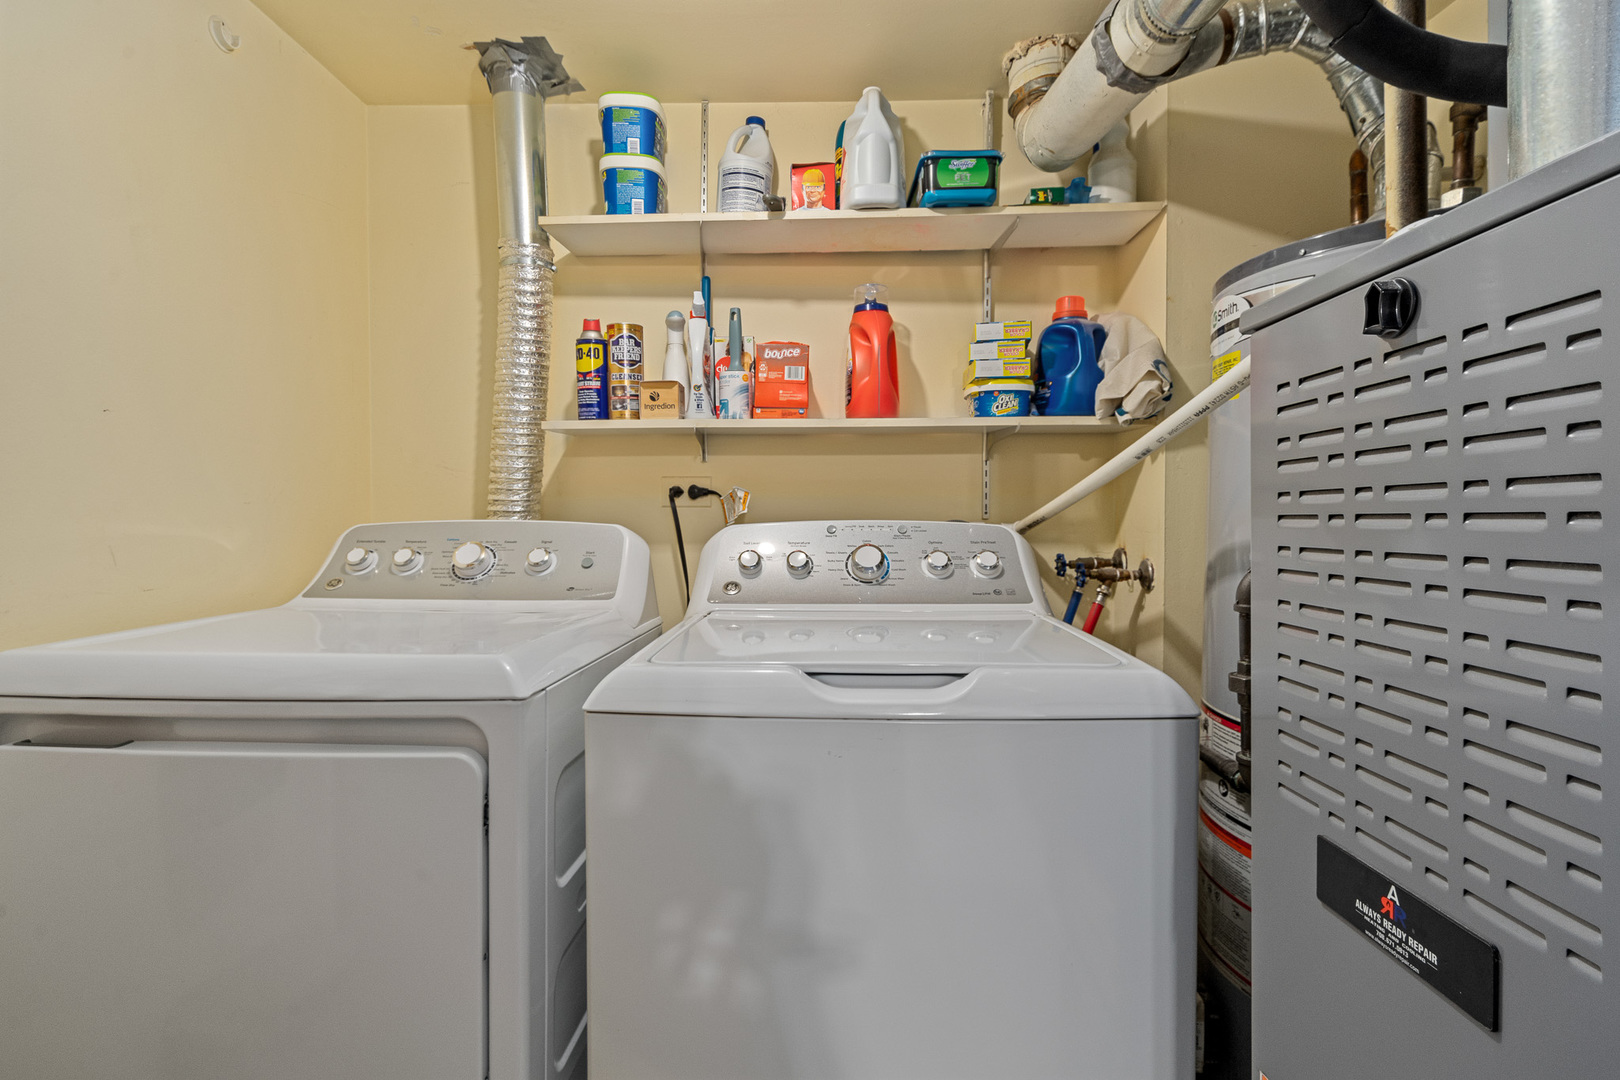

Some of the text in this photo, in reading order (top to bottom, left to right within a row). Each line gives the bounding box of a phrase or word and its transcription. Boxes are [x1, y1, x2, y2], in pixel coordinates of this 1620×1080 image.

[949, 159, 976, 170] Swiffer
[955, 173, 972, 181] PET
[618, 338, 635, 346] BAR
[611, 345, 642, 354] KEEPERS
[764, 348, 801, 359] bounce
[613, 352, 641, 361] FRIEND
[998, 394, 1014, 403] OXI
[644, 402, 676, 412] Ingredion
[993, 400, 1019, 411] CLEAN
[1355, 898, 1438, 966] ALWAYS READY REPAIR
[1363, 915, 1426, 964] HEATING AND COOLING
